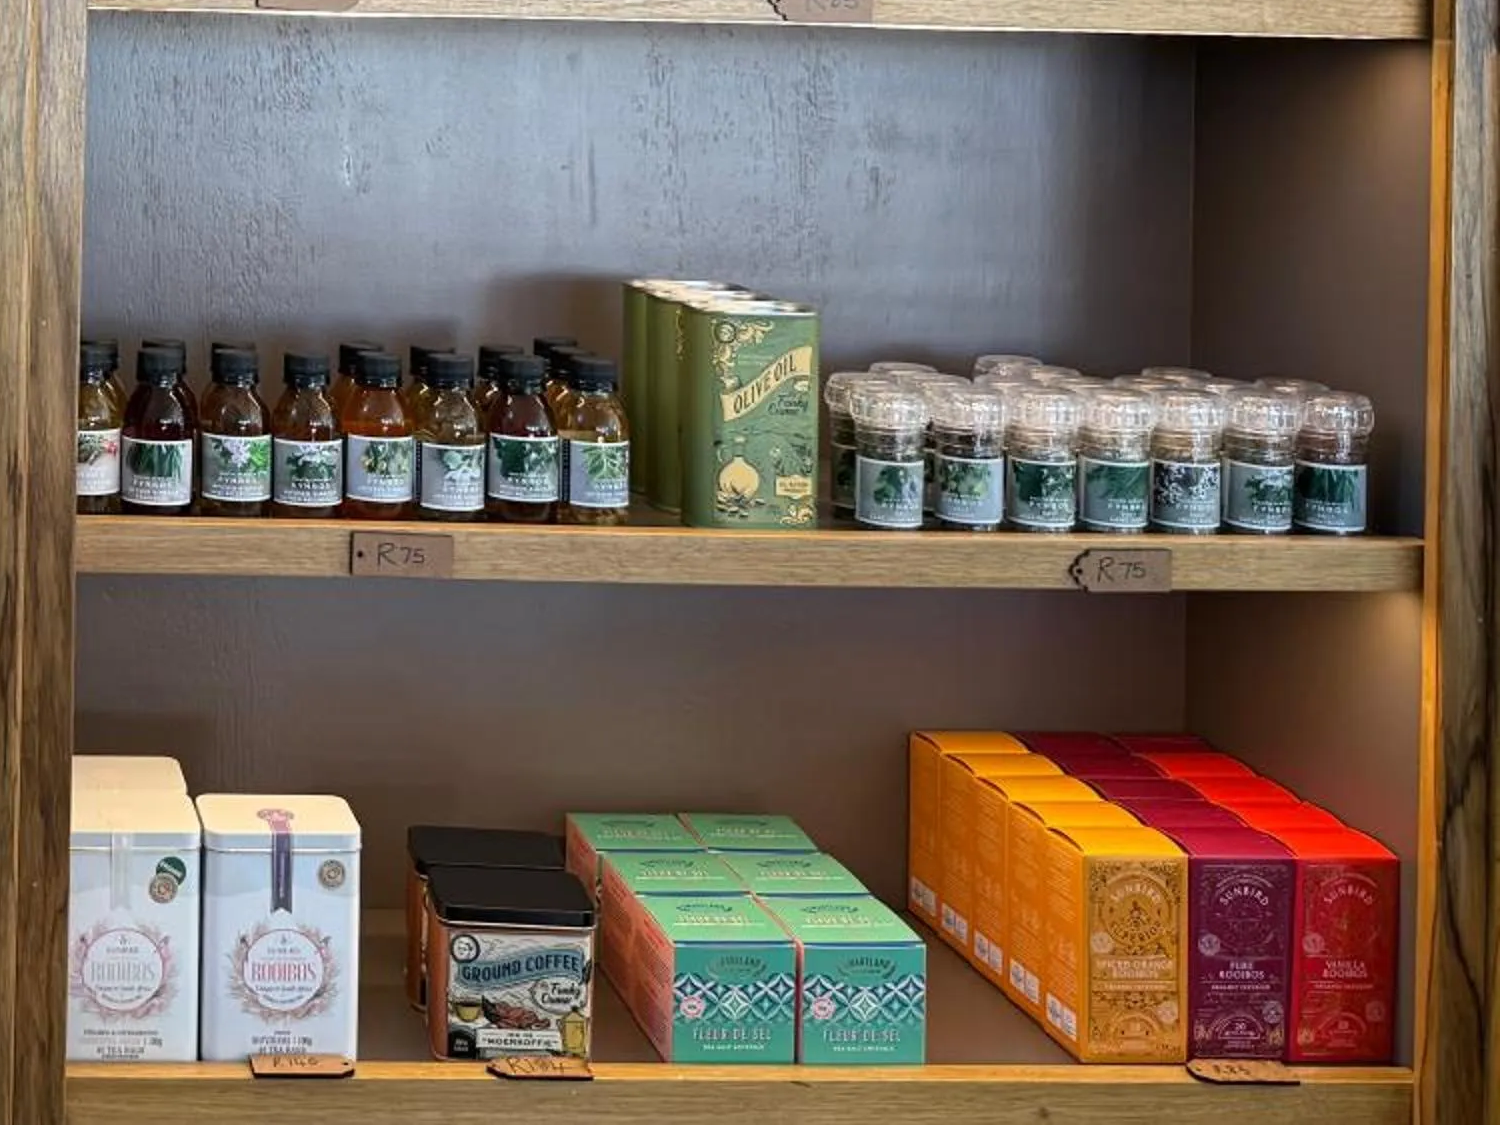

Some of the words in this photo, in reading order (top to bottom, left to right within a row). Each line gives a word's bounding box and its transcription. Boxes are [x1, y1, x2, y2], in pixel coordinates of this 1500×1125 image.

[733, 377, 769, 414] OLIVE
[773, 353, 797, 382] OIL
[377, 542, 425, 565] R75
[1097, 556, 1147, 582] R75
[1219, 887, 1269, 906] SUNBIRD
[252, 962, 316, 983] ROOIBOS
[461, 958, 521, 983] GROUND
[525, 954, 580, 974] COFFEE
[1218, 970, 1265, 980] ROOIBOS
[550, 982, 581, 1000] Funky
[693, 1028, 726, 1040] FLEUR
[752, 1028, 771, 1040] SEL
[823, 1030, 856, 1042] FLEUR
[883, 1030, 901, 1042] SEL
